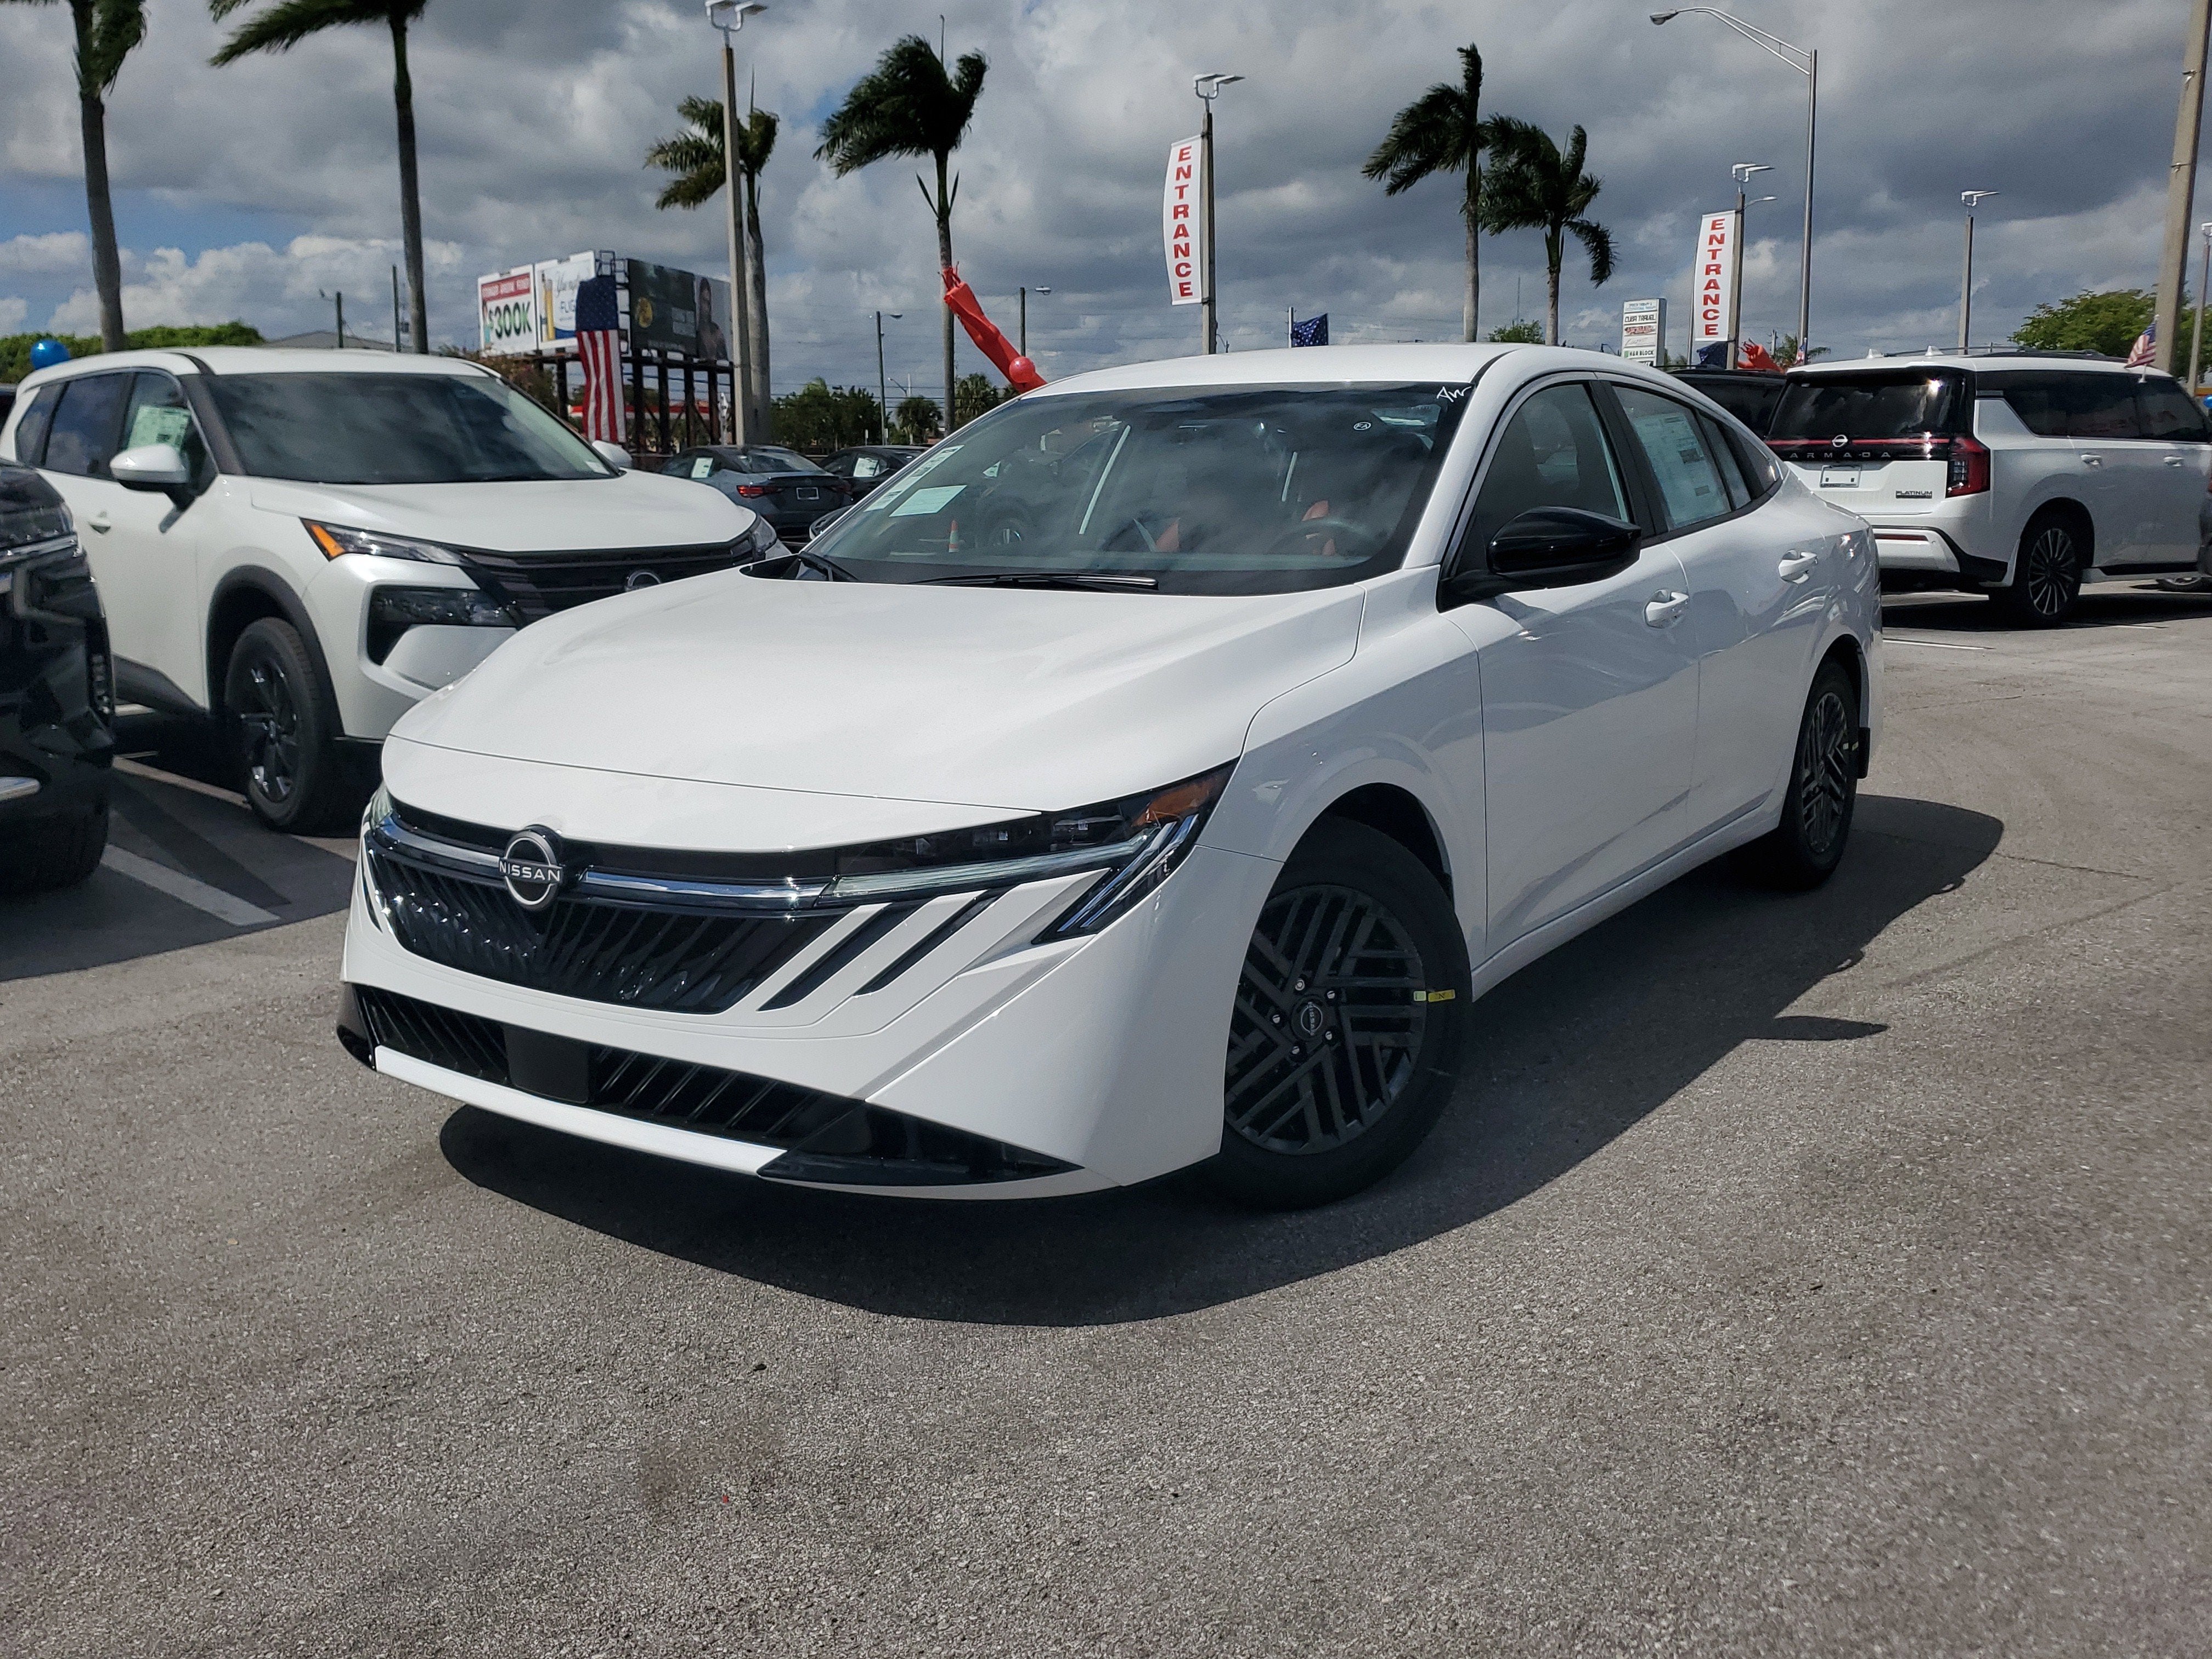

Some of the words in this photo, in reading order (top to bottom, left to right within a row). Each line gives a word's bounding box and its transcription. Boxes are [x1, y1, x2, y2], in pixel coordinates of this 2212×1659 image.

[1172, 145, 1193, 297] ENTRANCE
[1702, 218, 1725, 336] ENTRANCE
[499, 860, 560, 882] NISSAN
